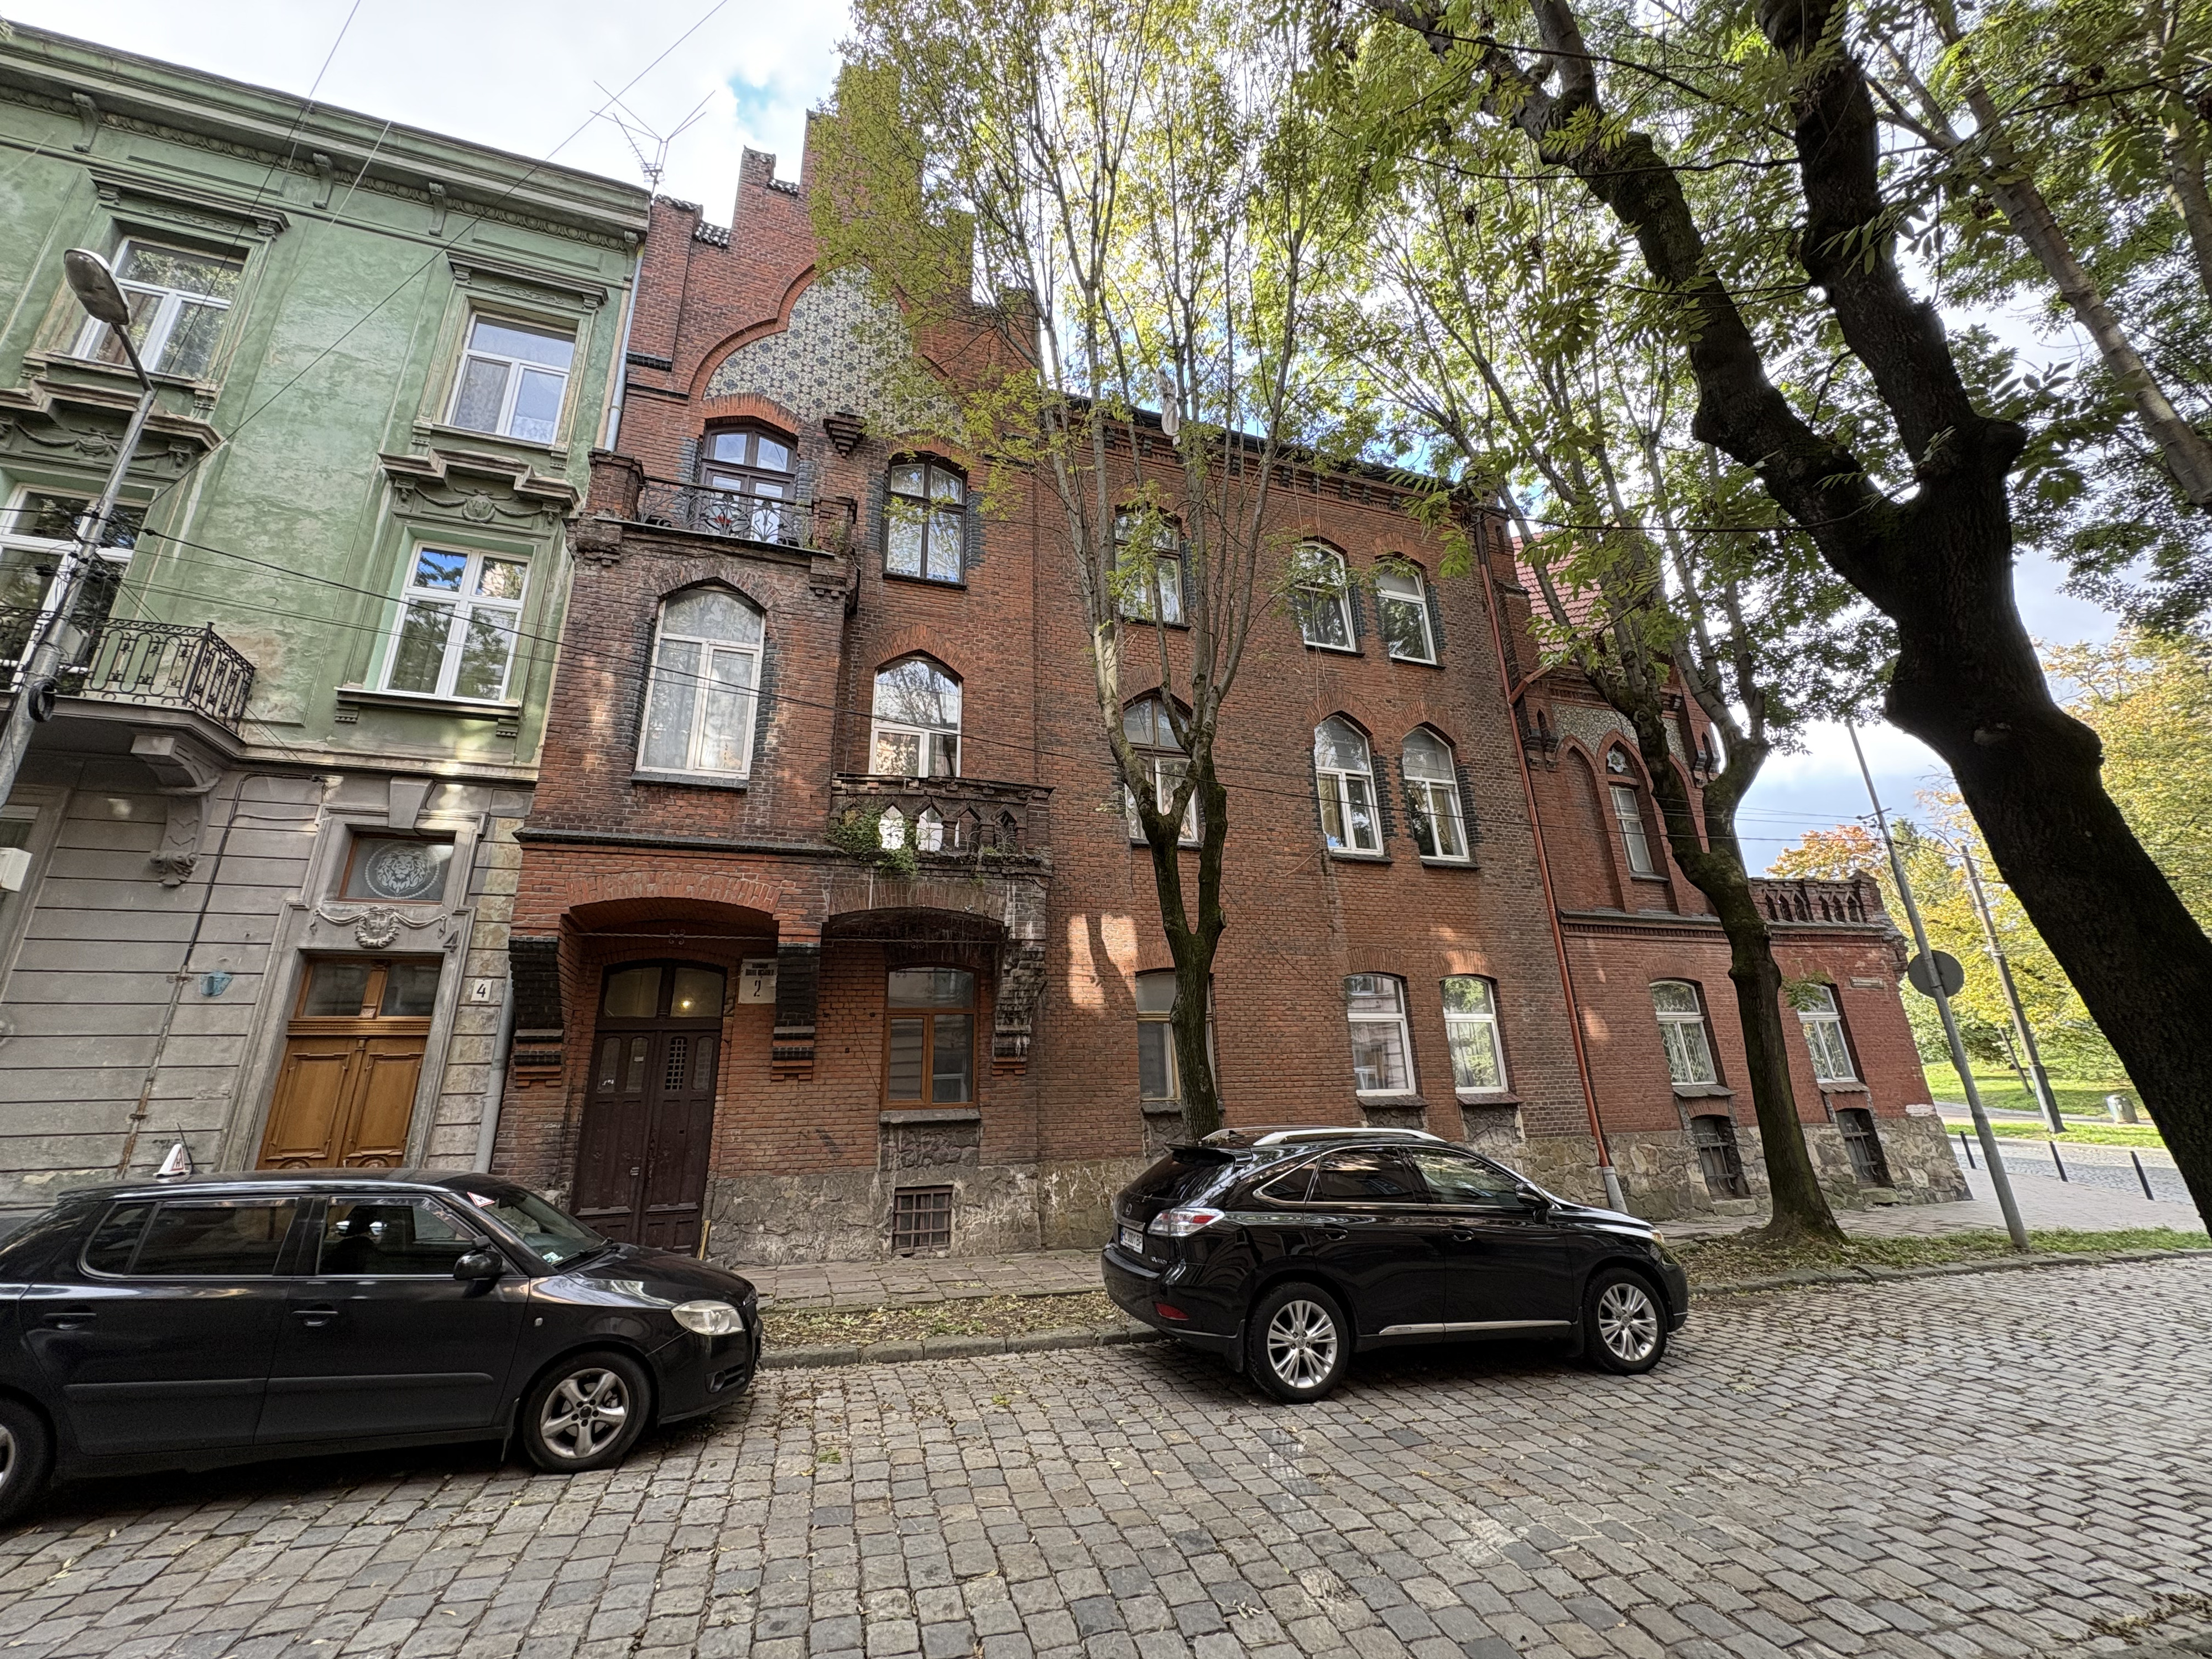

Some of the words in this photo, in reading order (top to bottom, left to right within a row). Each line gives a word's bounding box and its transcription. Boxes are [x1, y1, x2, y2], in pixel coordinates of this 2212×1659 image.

[442, 930, 459, 953] 4
[476, 984, 486, 998] 4
[754, 980, 761, 997] 2
